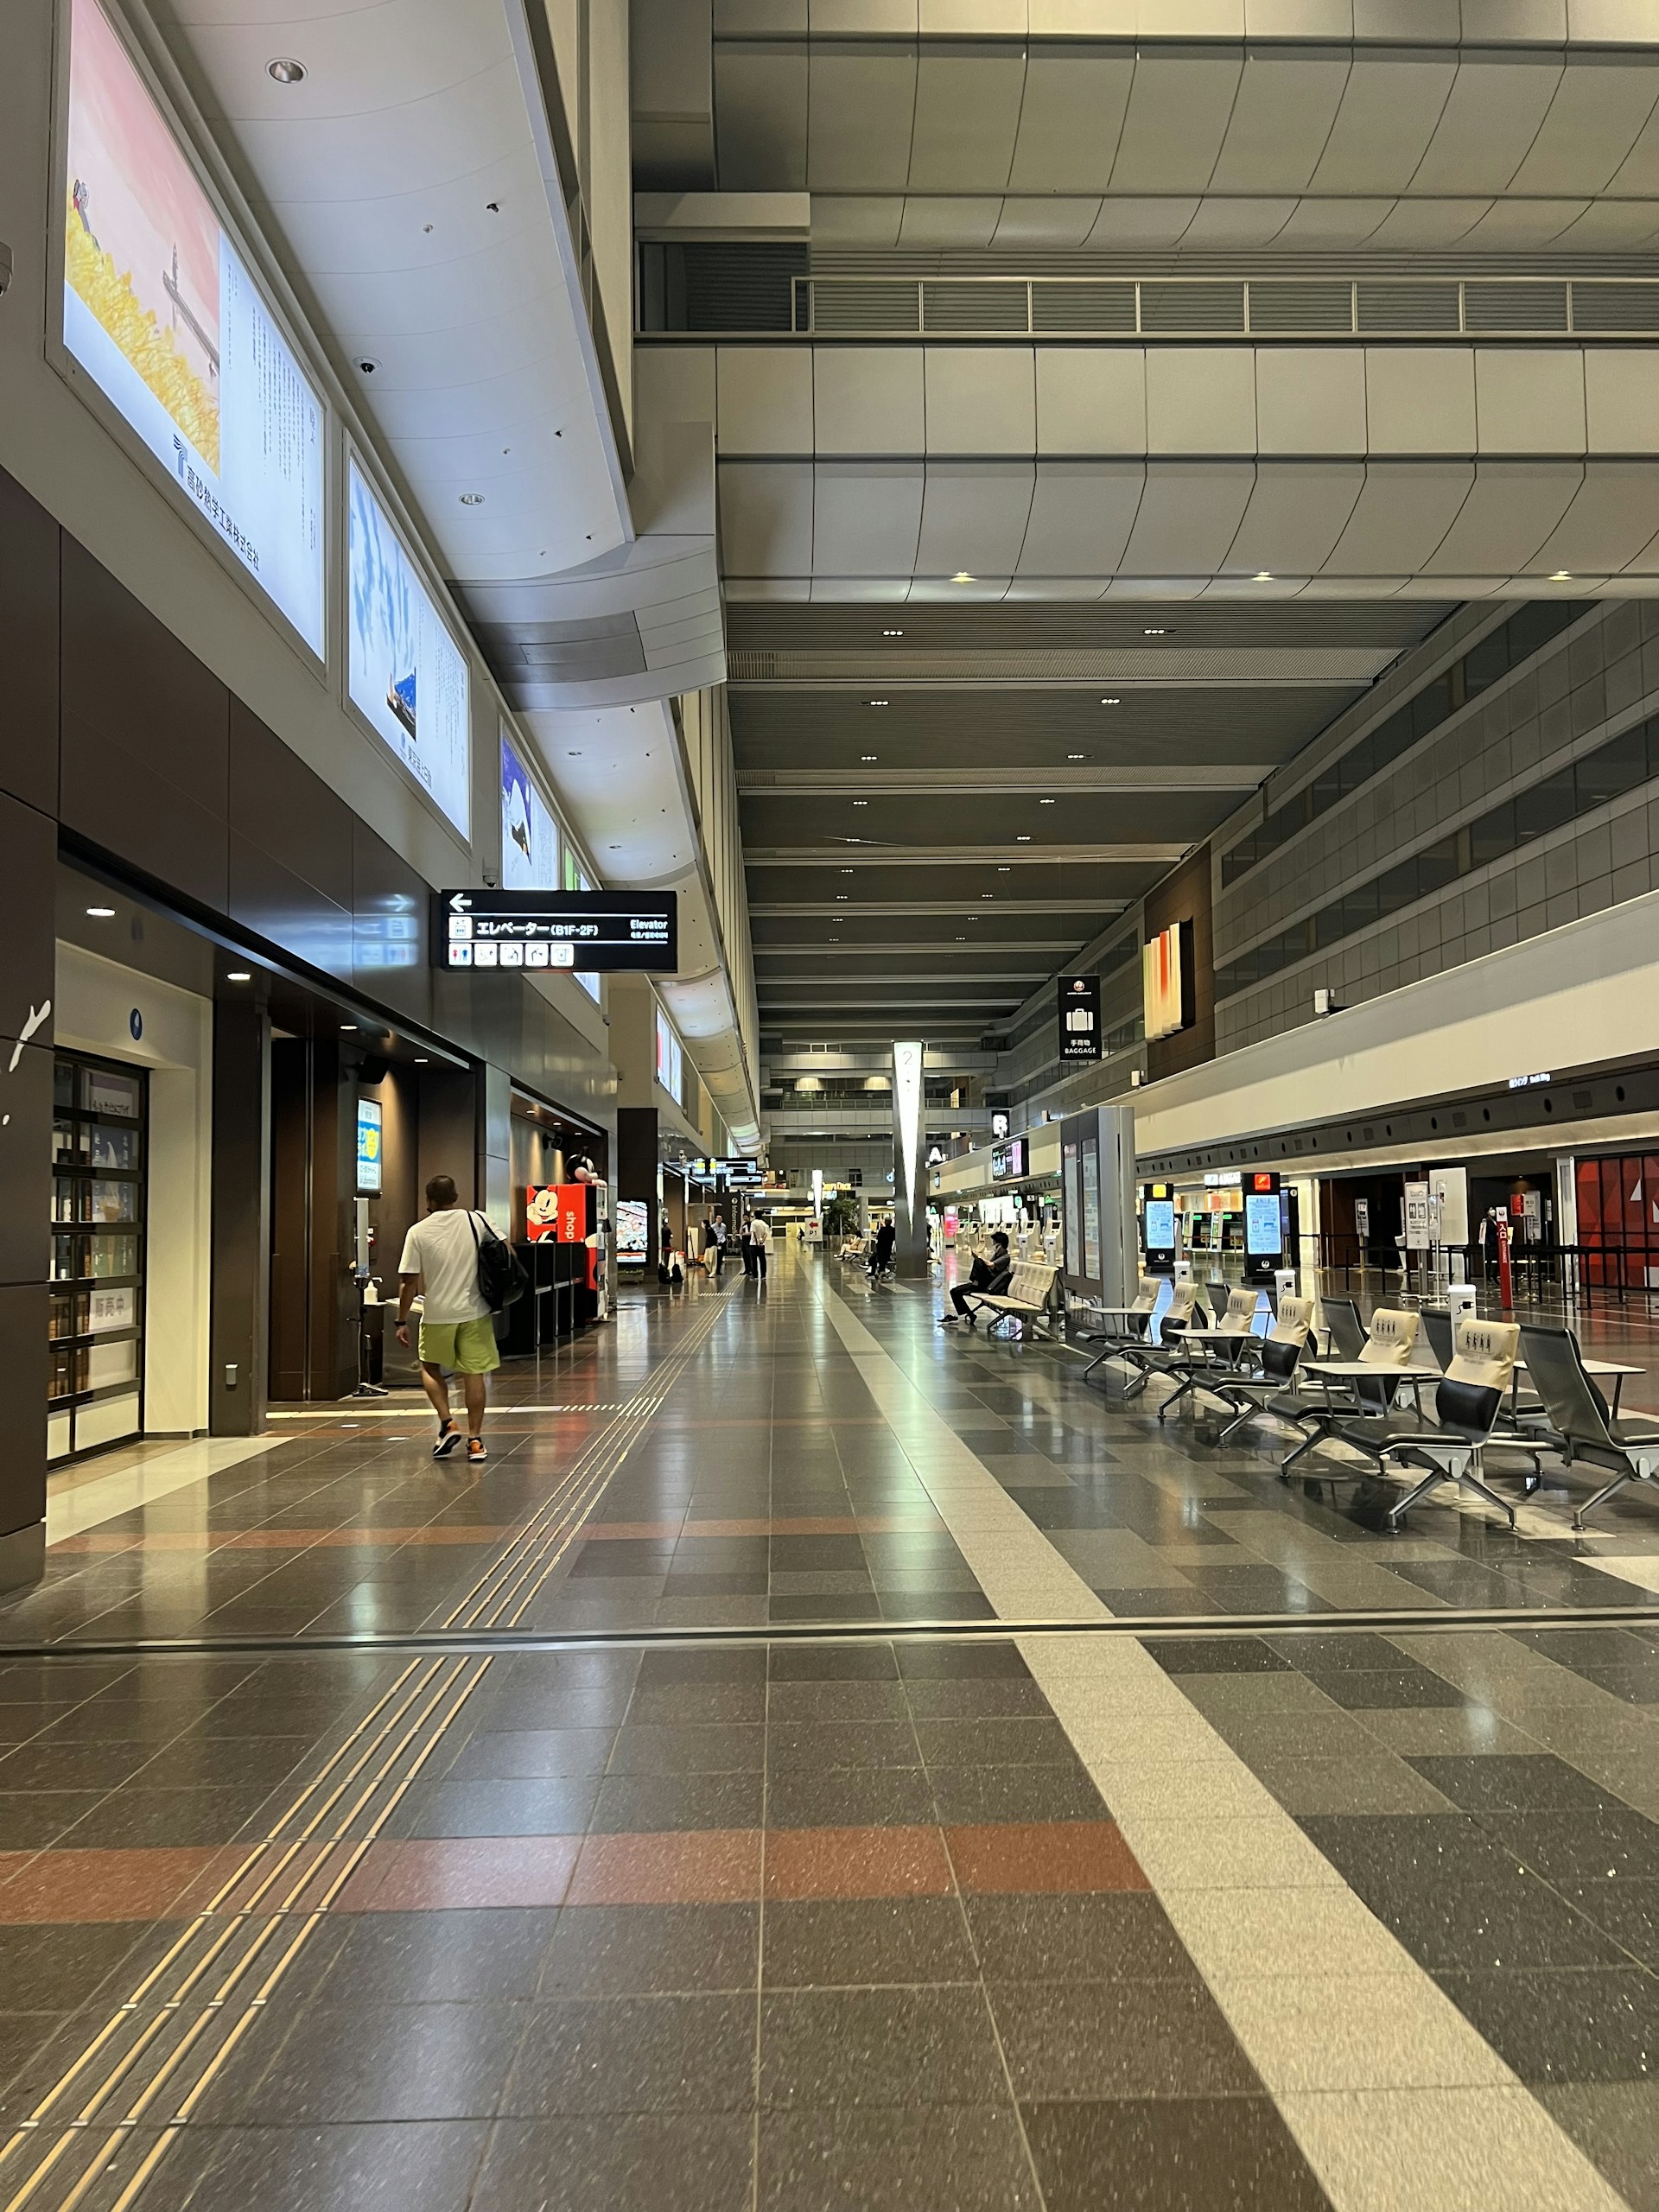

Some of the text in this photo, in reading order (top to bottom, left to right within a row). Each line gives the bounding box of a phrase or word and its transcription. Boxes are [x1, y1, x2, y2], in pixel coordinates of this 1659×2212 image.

[187, 465, 259, 572] 高砂熱学工業株式会社
[630, 919, 668, 930] Elevator
[903, 1051, 912, 1065] 2
[929, 1147, 942, 1162] A
[564, 1211, 576, 1242] shop
[1499, 1224, 1507, 1239] 入口
